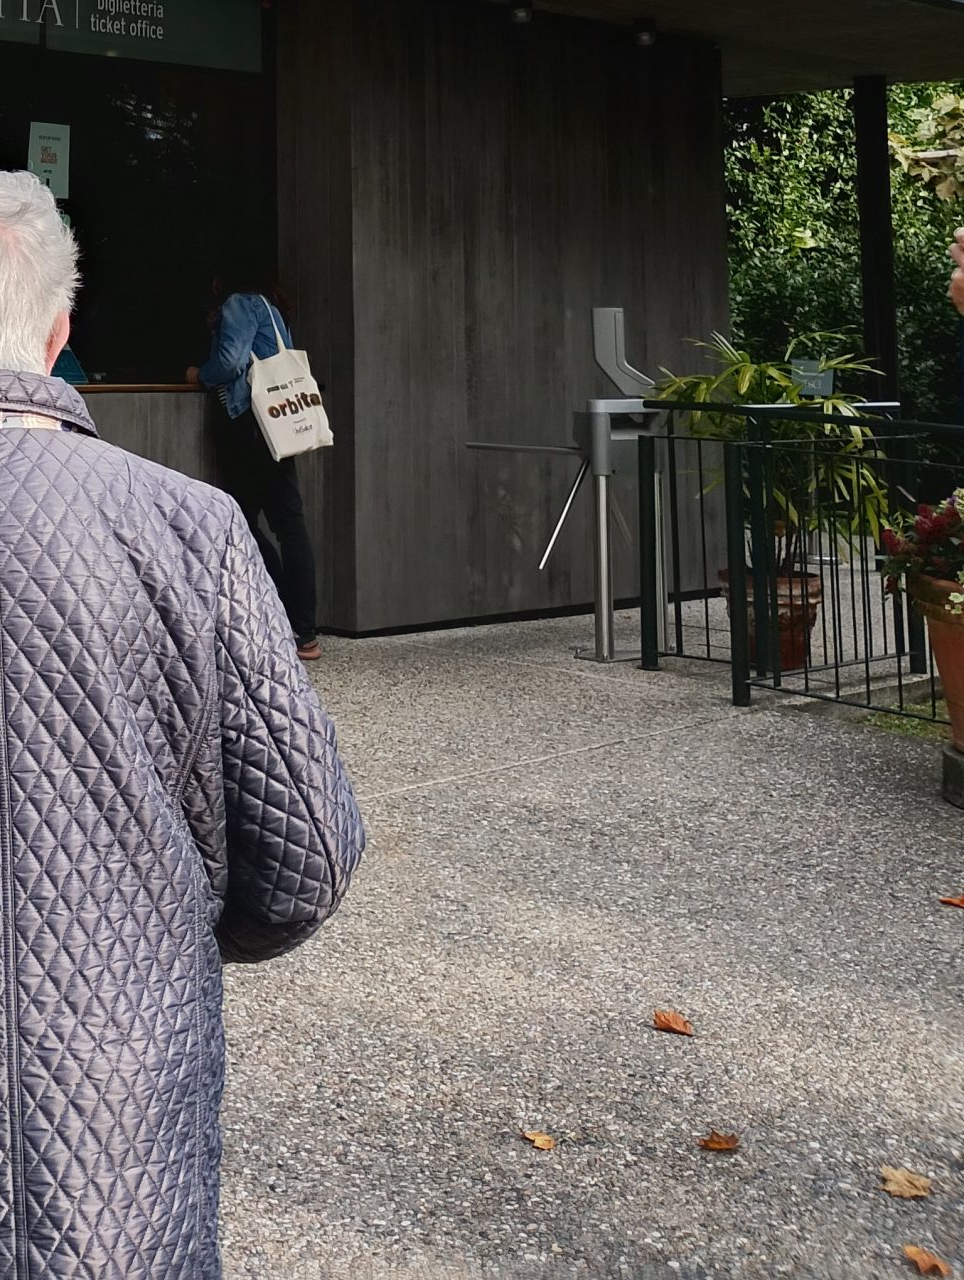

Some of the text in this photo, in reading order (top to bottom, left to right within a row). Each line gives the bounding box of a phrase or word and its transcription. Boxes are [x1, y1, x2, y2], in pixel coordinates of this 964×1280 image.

[90, 13, 164, 40] ticket office
[267, 391, 321, 419] orbita
